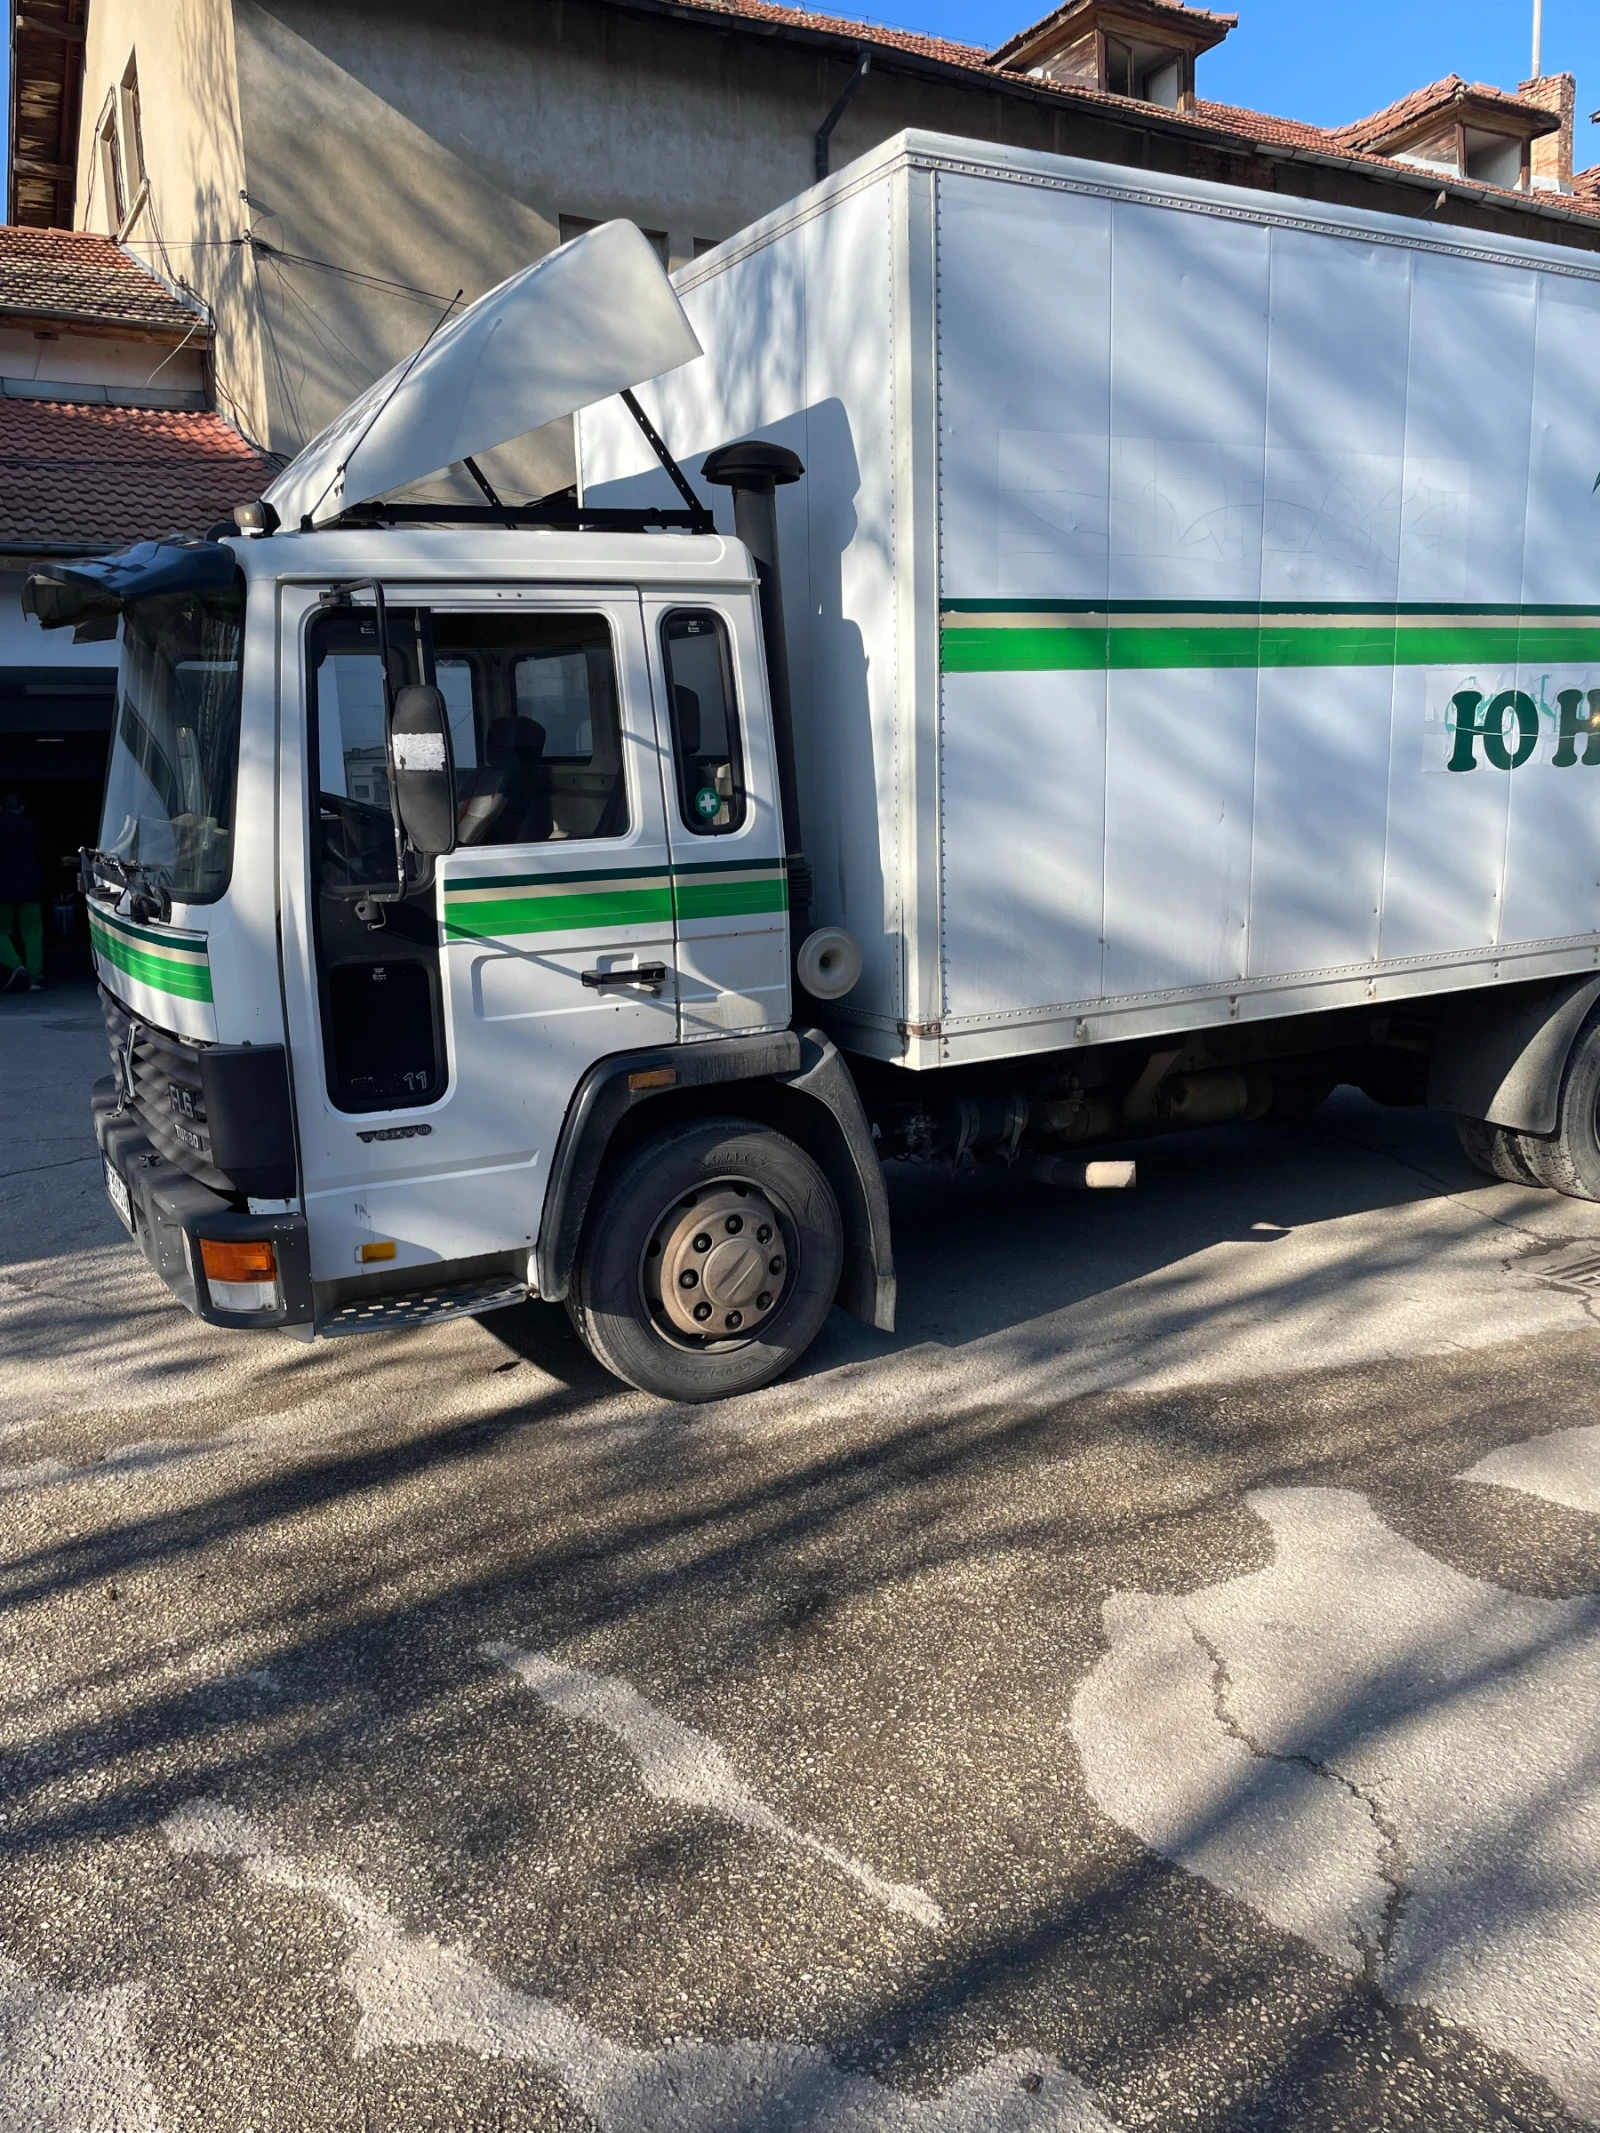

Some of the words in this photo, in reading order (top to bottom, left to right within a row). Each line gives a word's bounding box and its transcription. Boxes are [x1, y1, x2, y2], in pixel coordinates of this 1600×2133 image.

[403, 1071, 427, 1090] 11
[170, 1085, 194, 1118] FL6
[174, 1123, 199, 1149] TURBO
[356, 1124, 432, 1143] VOLVO
